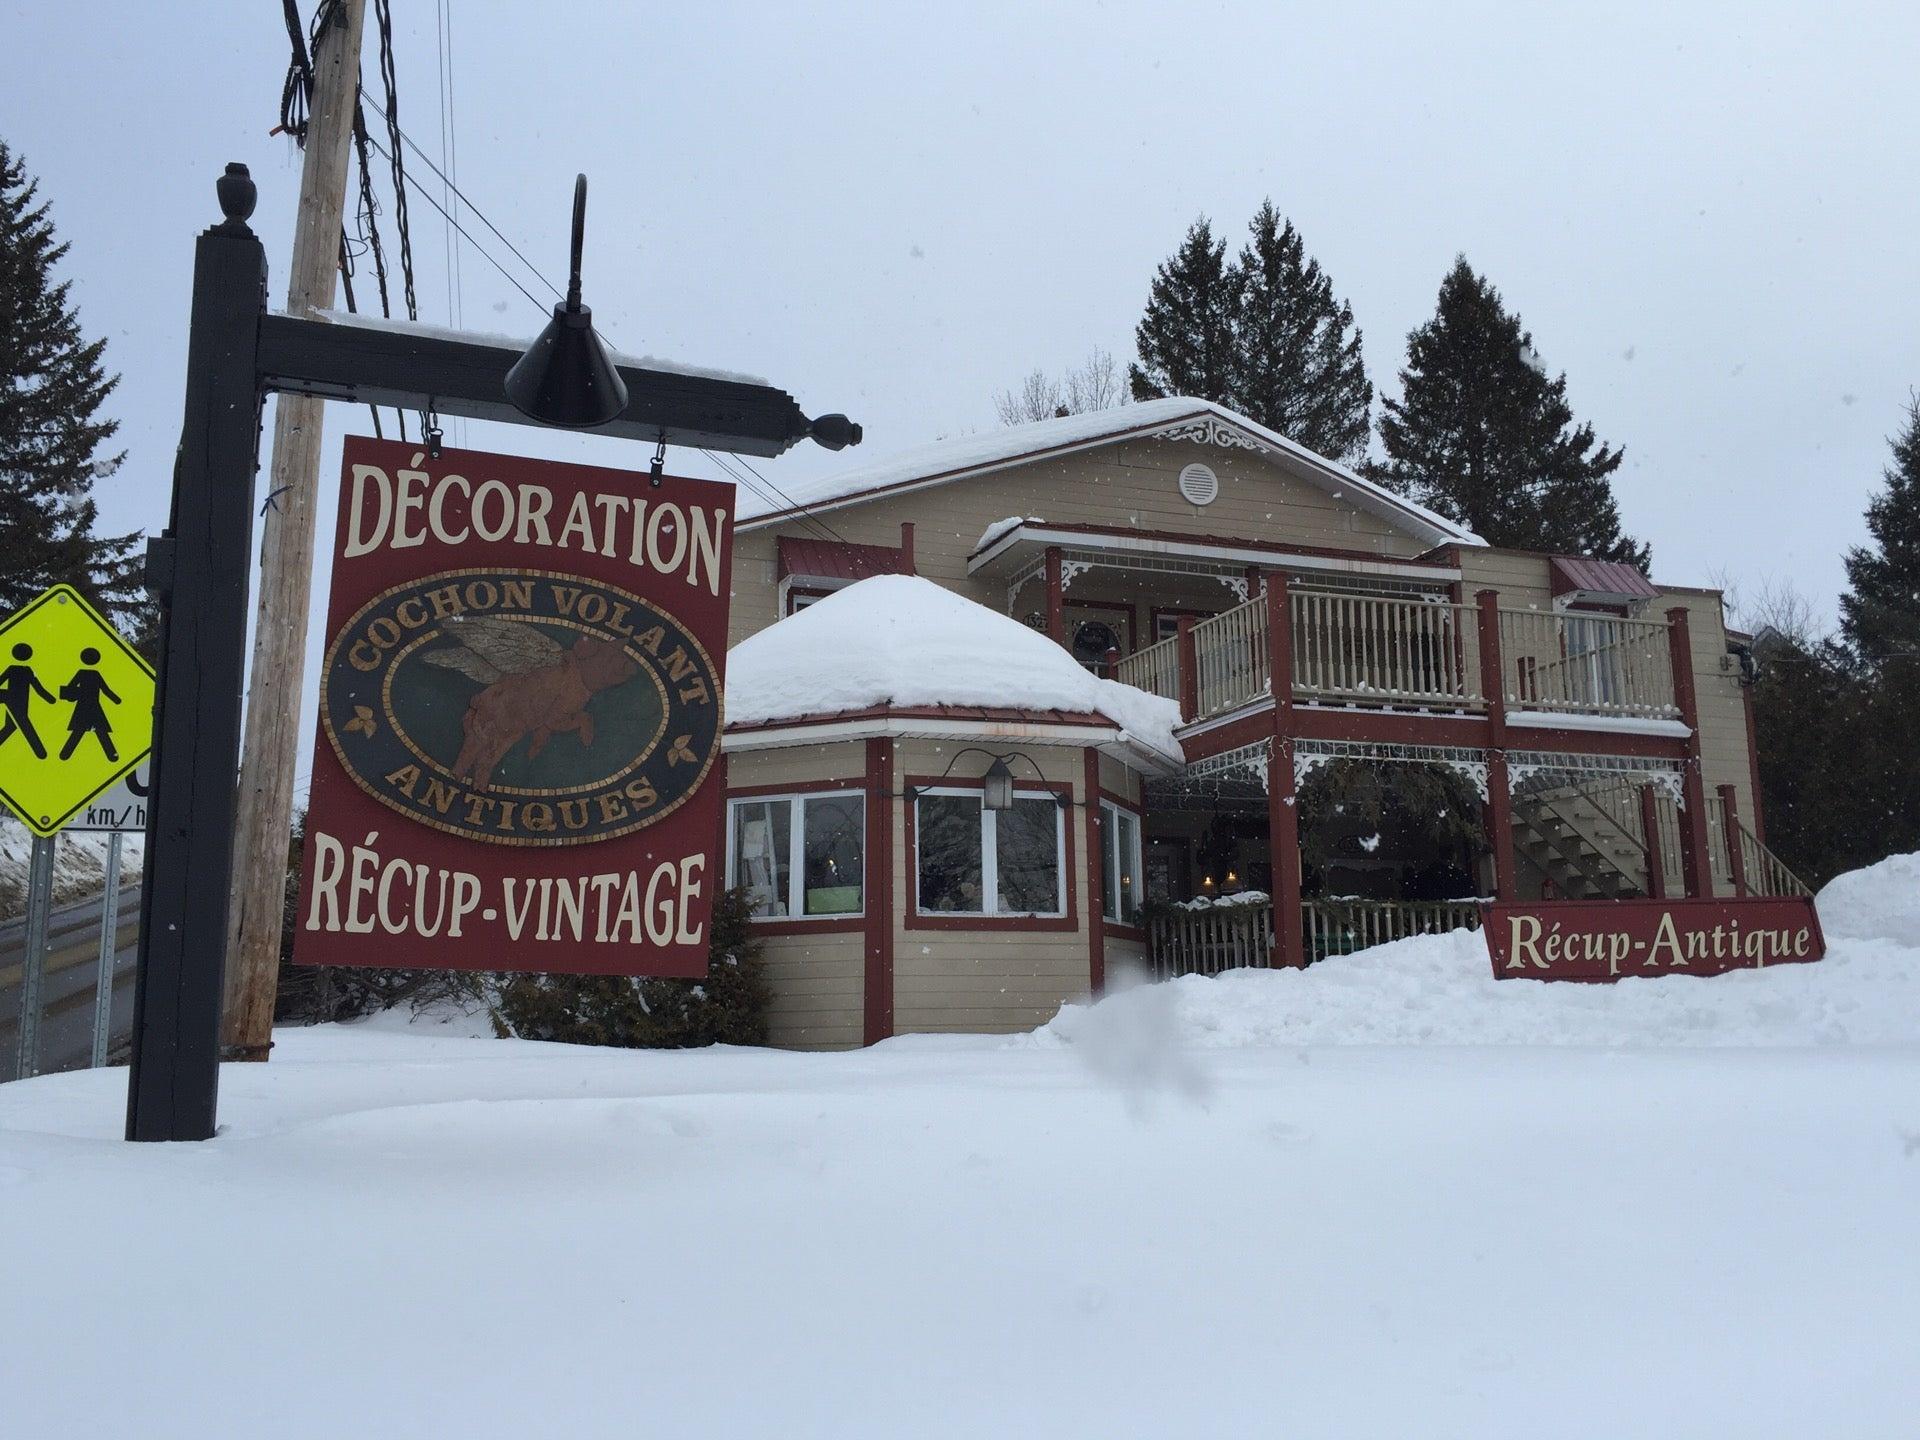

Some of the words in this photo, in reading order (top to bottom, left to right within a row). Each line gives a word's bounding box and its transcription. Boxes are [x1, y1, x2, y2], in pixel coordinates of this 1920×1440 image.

[344, 452, 726, 596] DÉCORATION
[348, 580, 533, 673] COCHON
[551, 584, 709, 705] VOLANT
[87, 805, 145, 825] km/h
[384, 762, 658, 832] ANTIQUES
[305, 831, 706, 947] RÉCUP-VINTAGE
[1506, 912, 1810, 976] Récup-Antique
